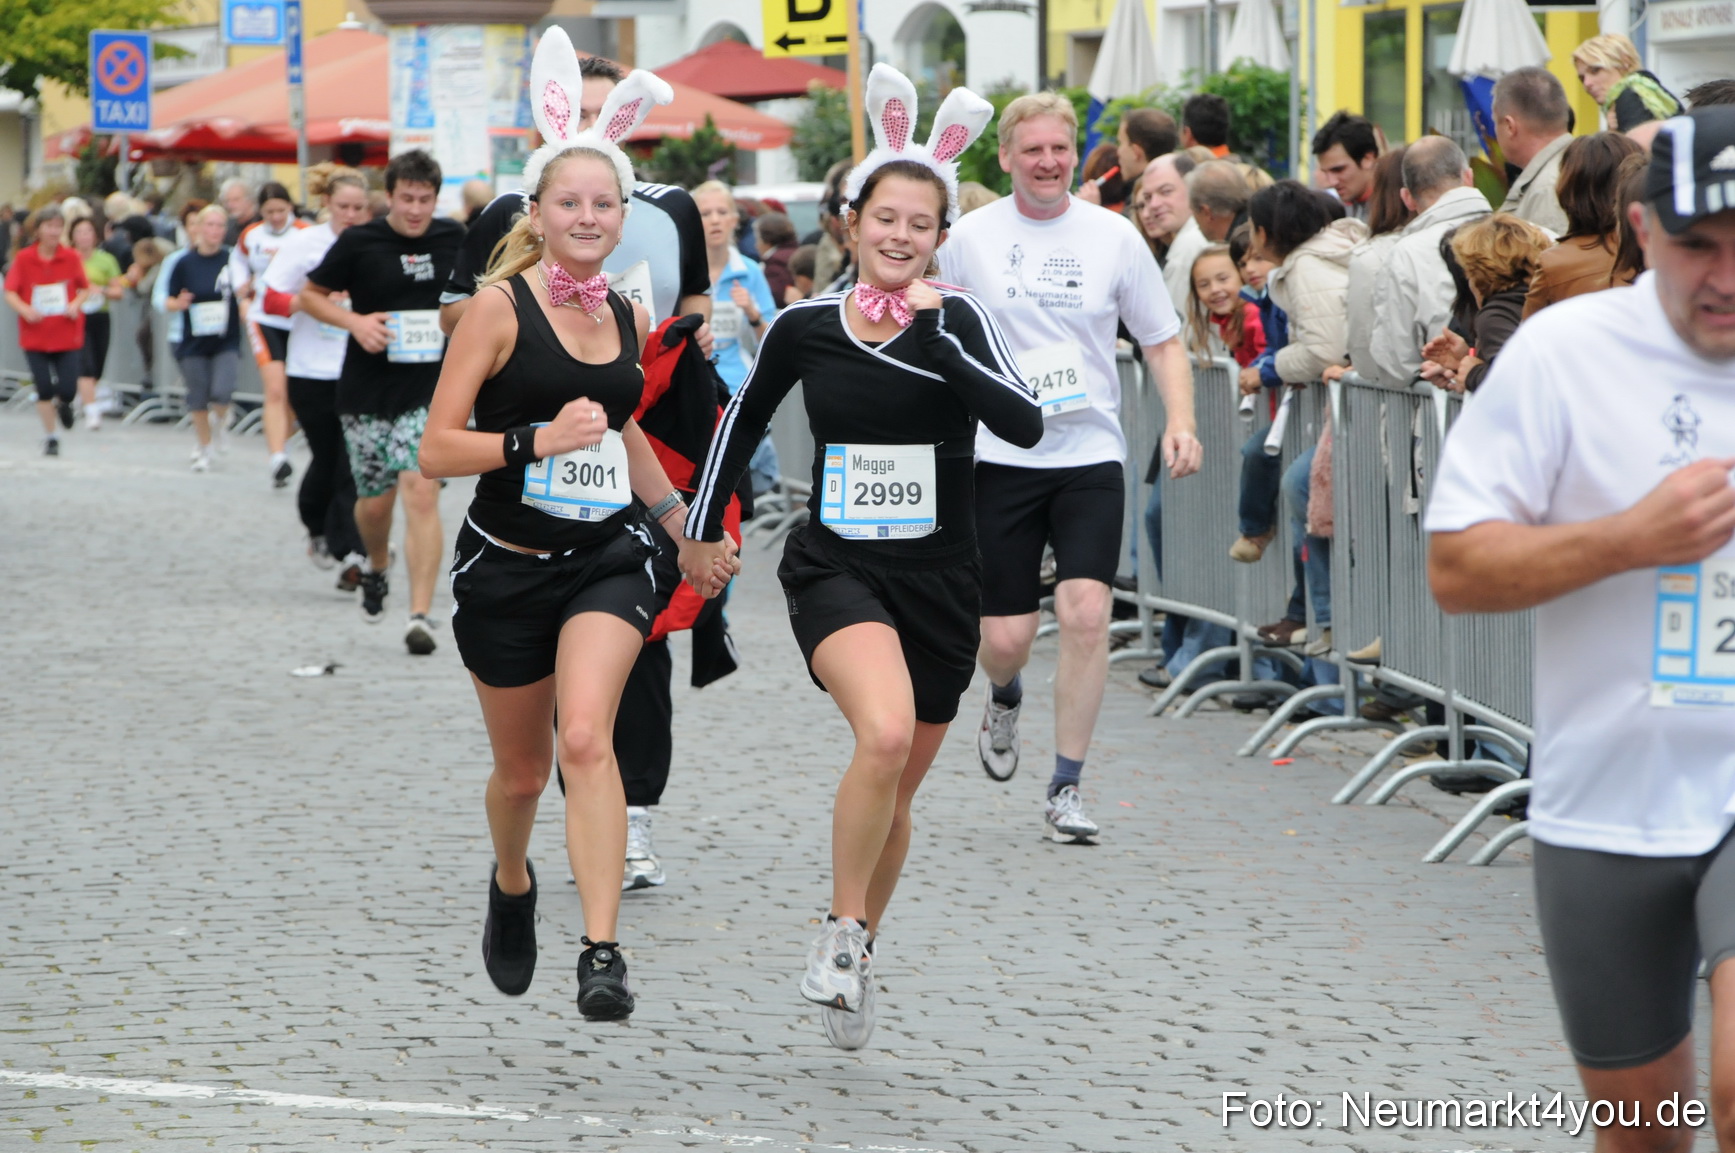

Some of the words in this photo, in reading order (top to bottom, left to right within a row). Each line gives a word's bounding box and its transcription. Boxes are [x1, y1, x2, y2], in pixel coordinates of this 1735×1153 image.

[96, 99, 148, 125] TAXI
[1037, 298, 1083, 310] Stadtlauf
[1028, 367, 1078, 394] 2478
[561, 460, 618, 490] 3001
[852, 453, 896, 475] Magga
[853, 481, 923, 506] 2999
[890, 523, 934, 533] PFLEIDERER
